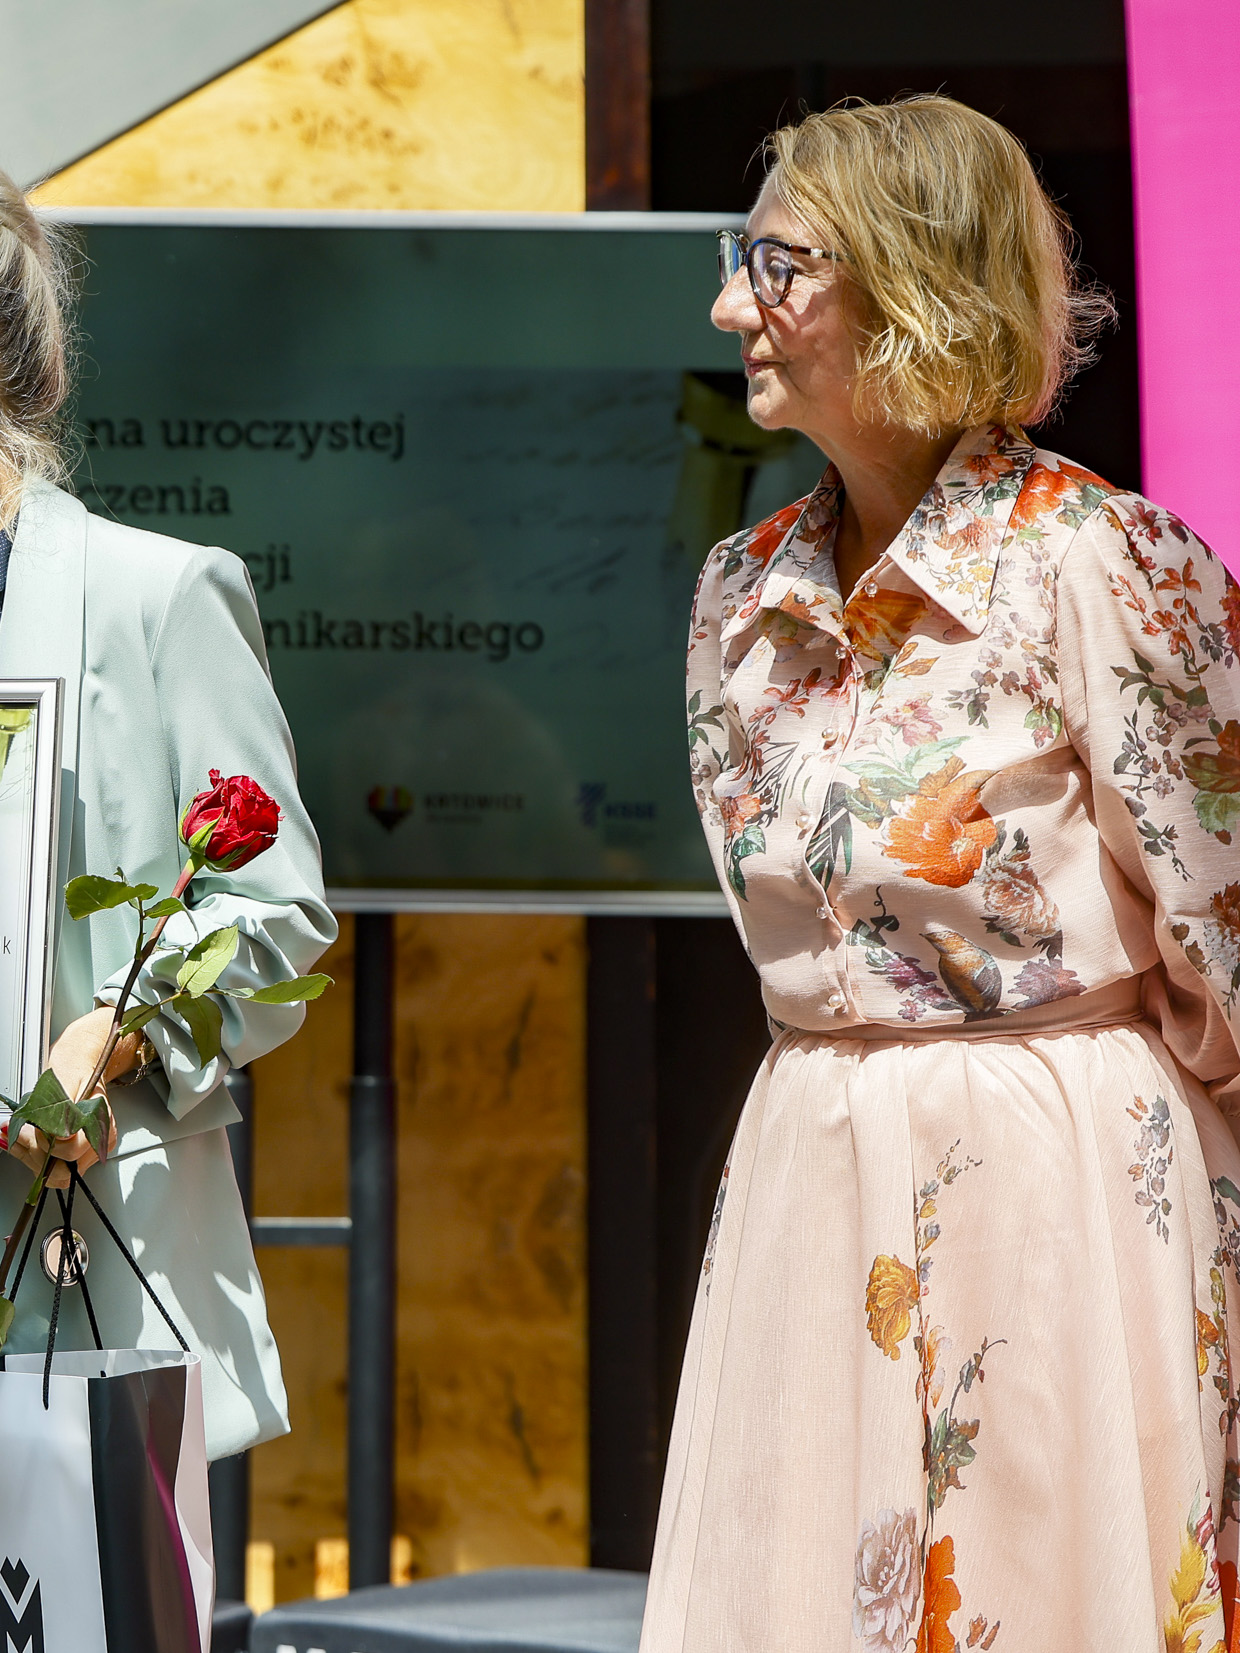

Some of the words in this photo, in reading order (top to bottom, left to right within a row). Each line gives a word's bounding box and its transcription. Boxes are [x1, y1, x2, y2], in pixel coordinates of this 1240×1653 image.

[86, 417, 145, 448] na
[161, 412, 405, 462] uroczystej
[78, 475, 231, 515] czenia
[242, 544, 292, 592] cji
[266, 611, 545, 662] nikarskiego
